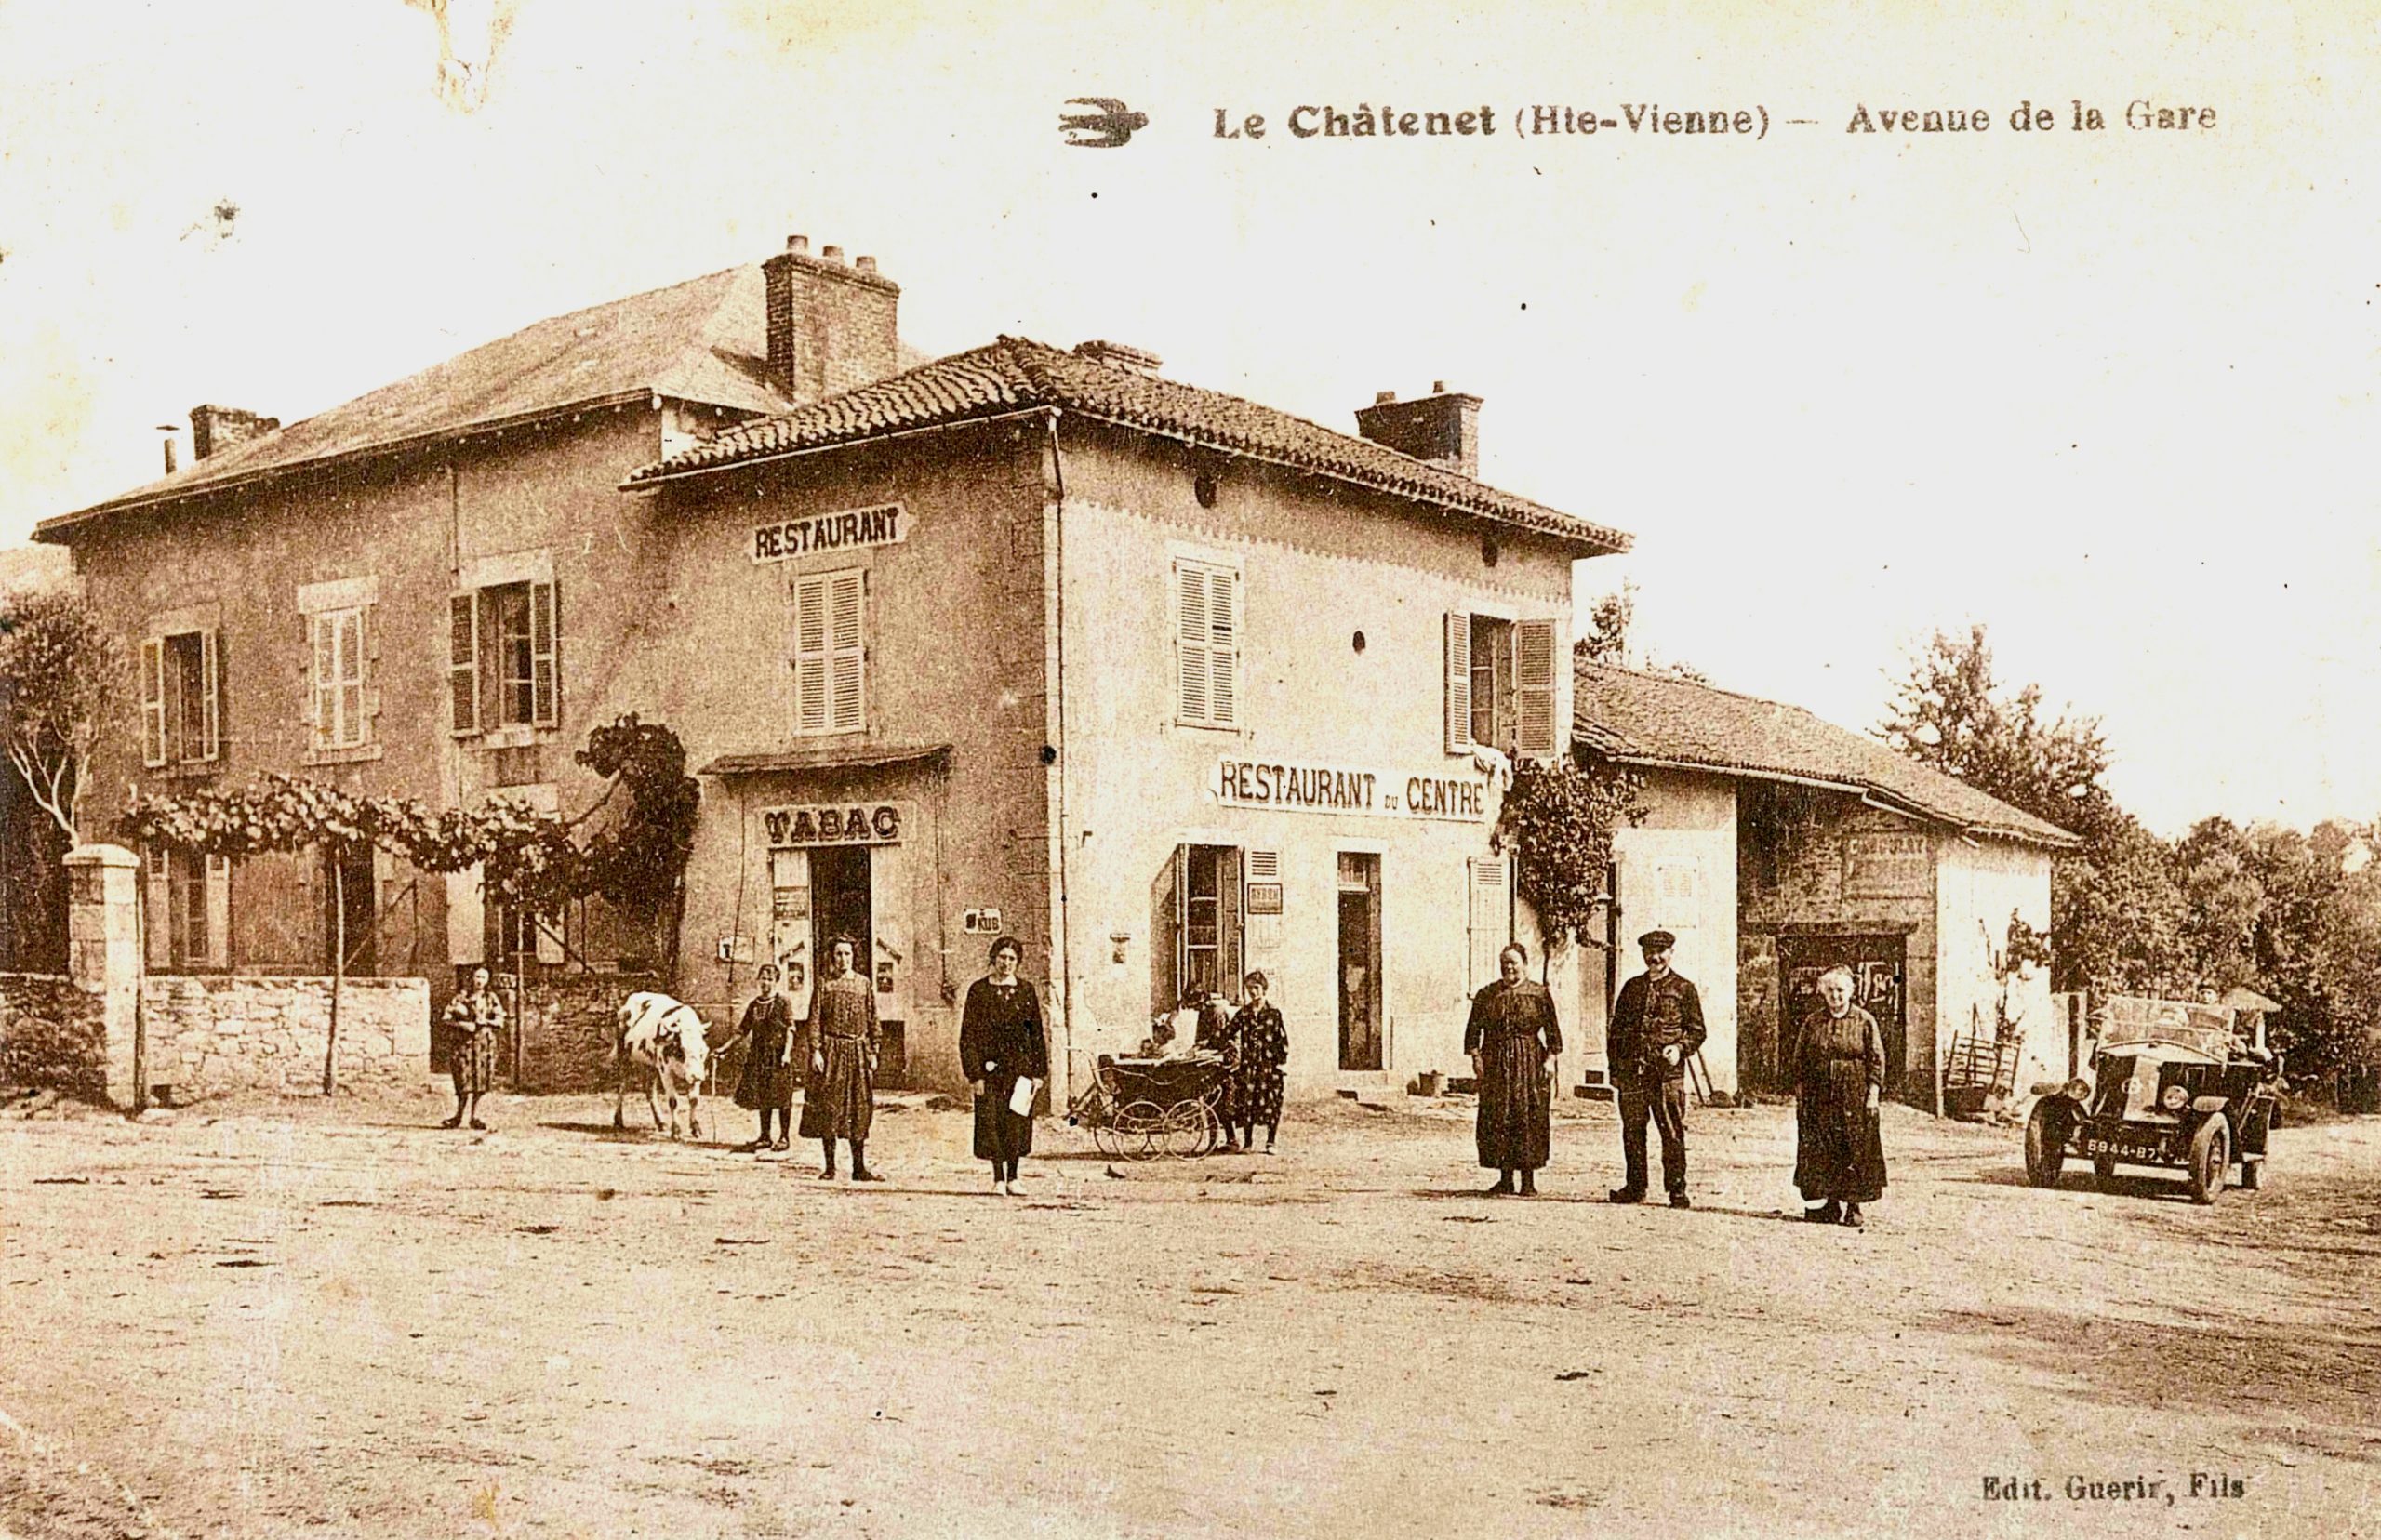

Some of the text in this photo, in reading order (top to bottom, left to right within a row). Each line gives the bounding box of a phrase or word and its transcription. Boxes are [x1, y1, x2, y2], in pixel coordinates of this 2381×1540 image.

[755, 507, 898, 558] RESTAURANT
[1220, 761, 1484, 815] RESTAURANT DU CENTRE
[765, 806, 901, 843] TABAC
